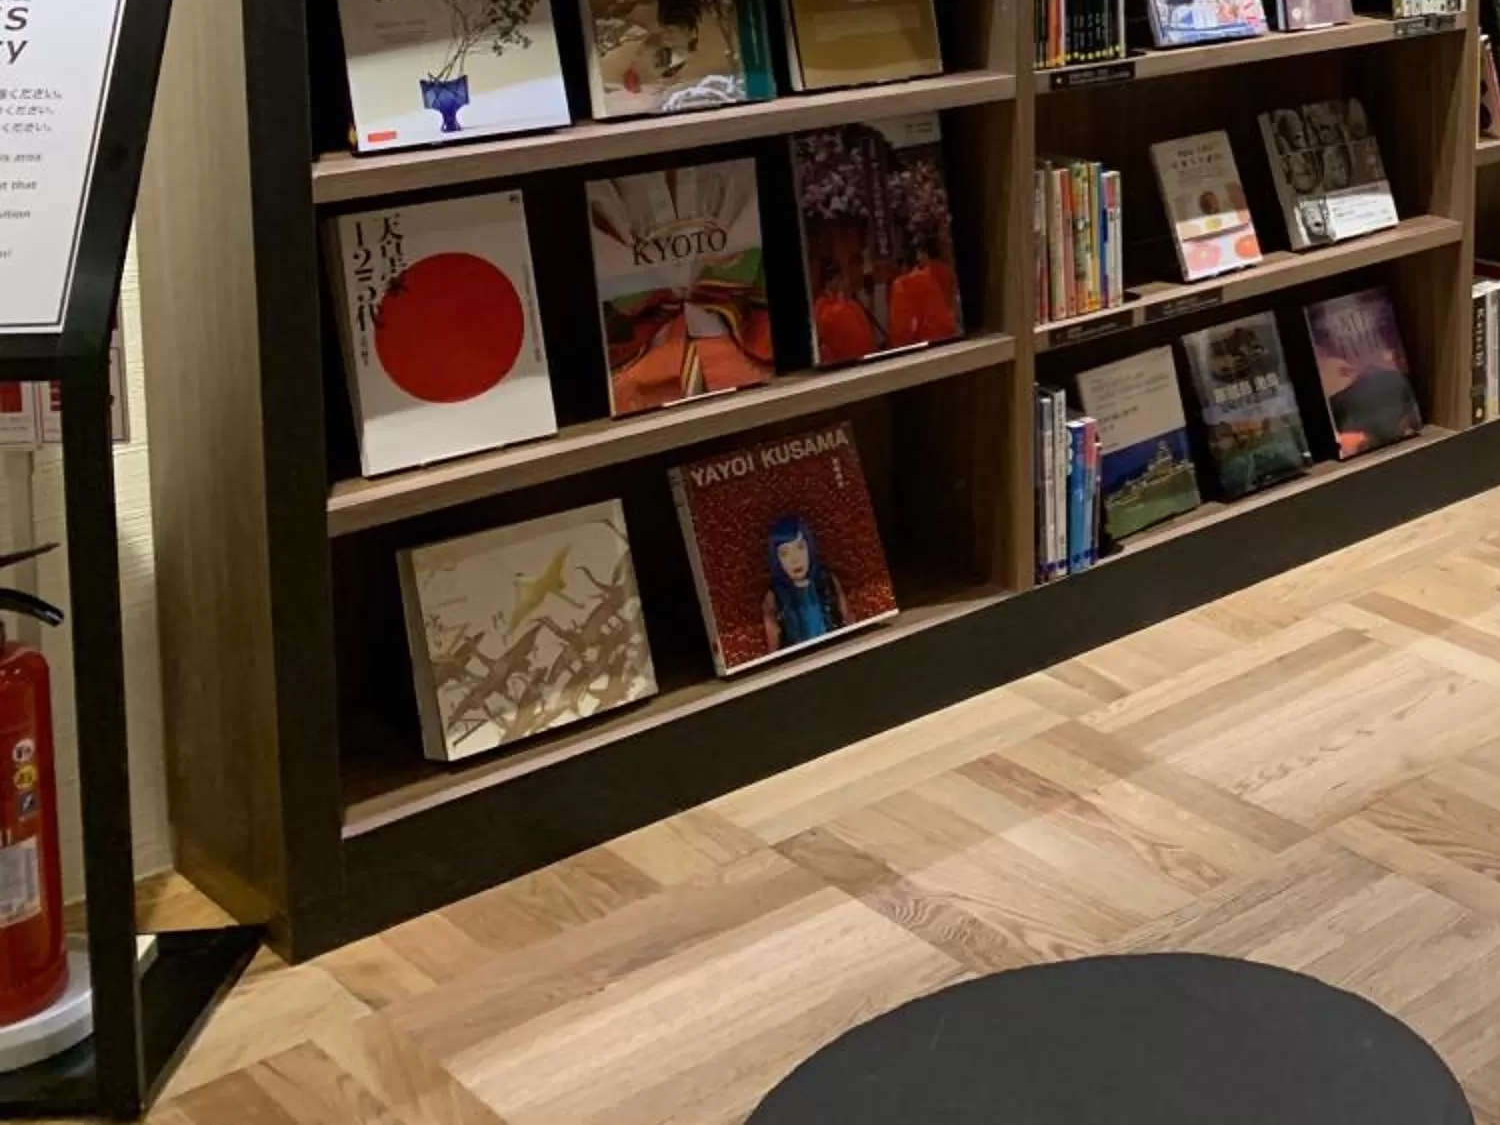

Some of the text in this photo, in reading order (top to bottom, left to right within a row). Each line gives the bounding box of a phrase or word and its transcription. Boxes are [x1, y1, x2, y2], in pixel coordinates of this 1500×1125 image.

[632, 227, 729, 266] KYOTO
[690, 427, 850, 488] YAYOI KUSAMA
